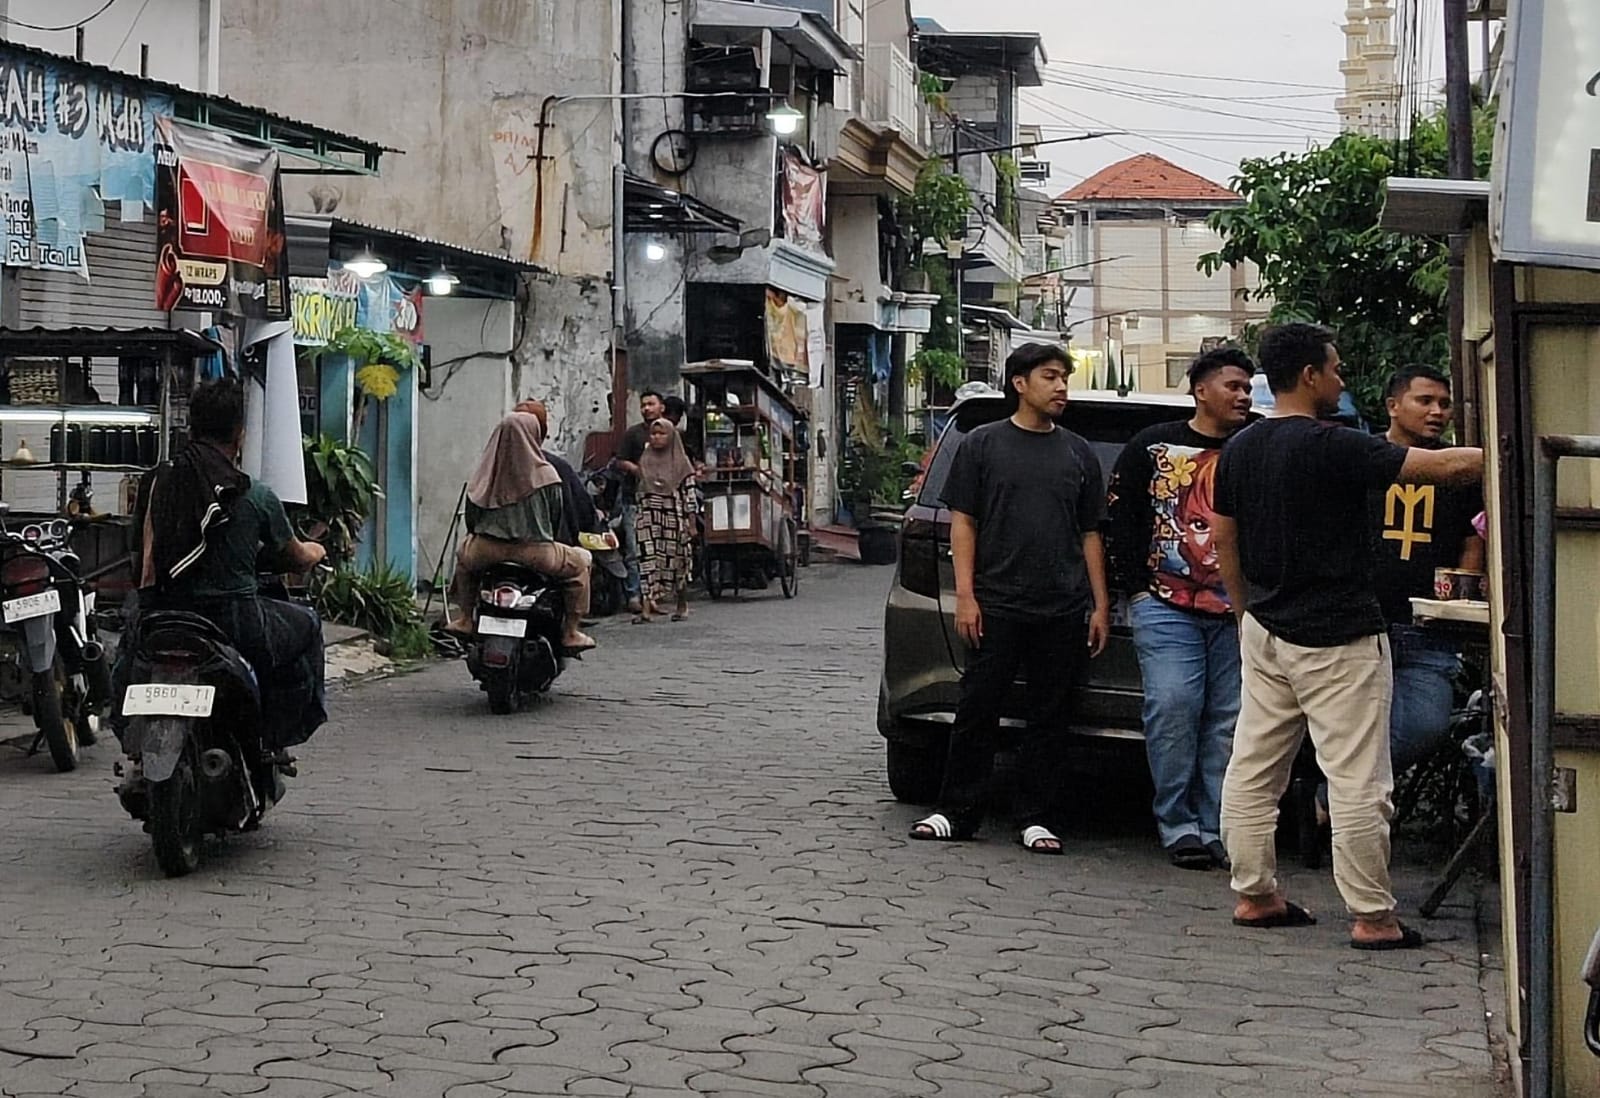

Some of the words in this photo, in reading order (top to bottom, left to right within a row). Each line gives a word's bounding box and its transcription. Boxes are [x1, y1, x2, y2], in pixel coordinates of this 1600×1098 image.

[0, 66, 46, 130] AH
[157, 149, 178, 167] NEW
[194, 266, 218, 280] WRAPS
[128, 688, 136, 700] L
